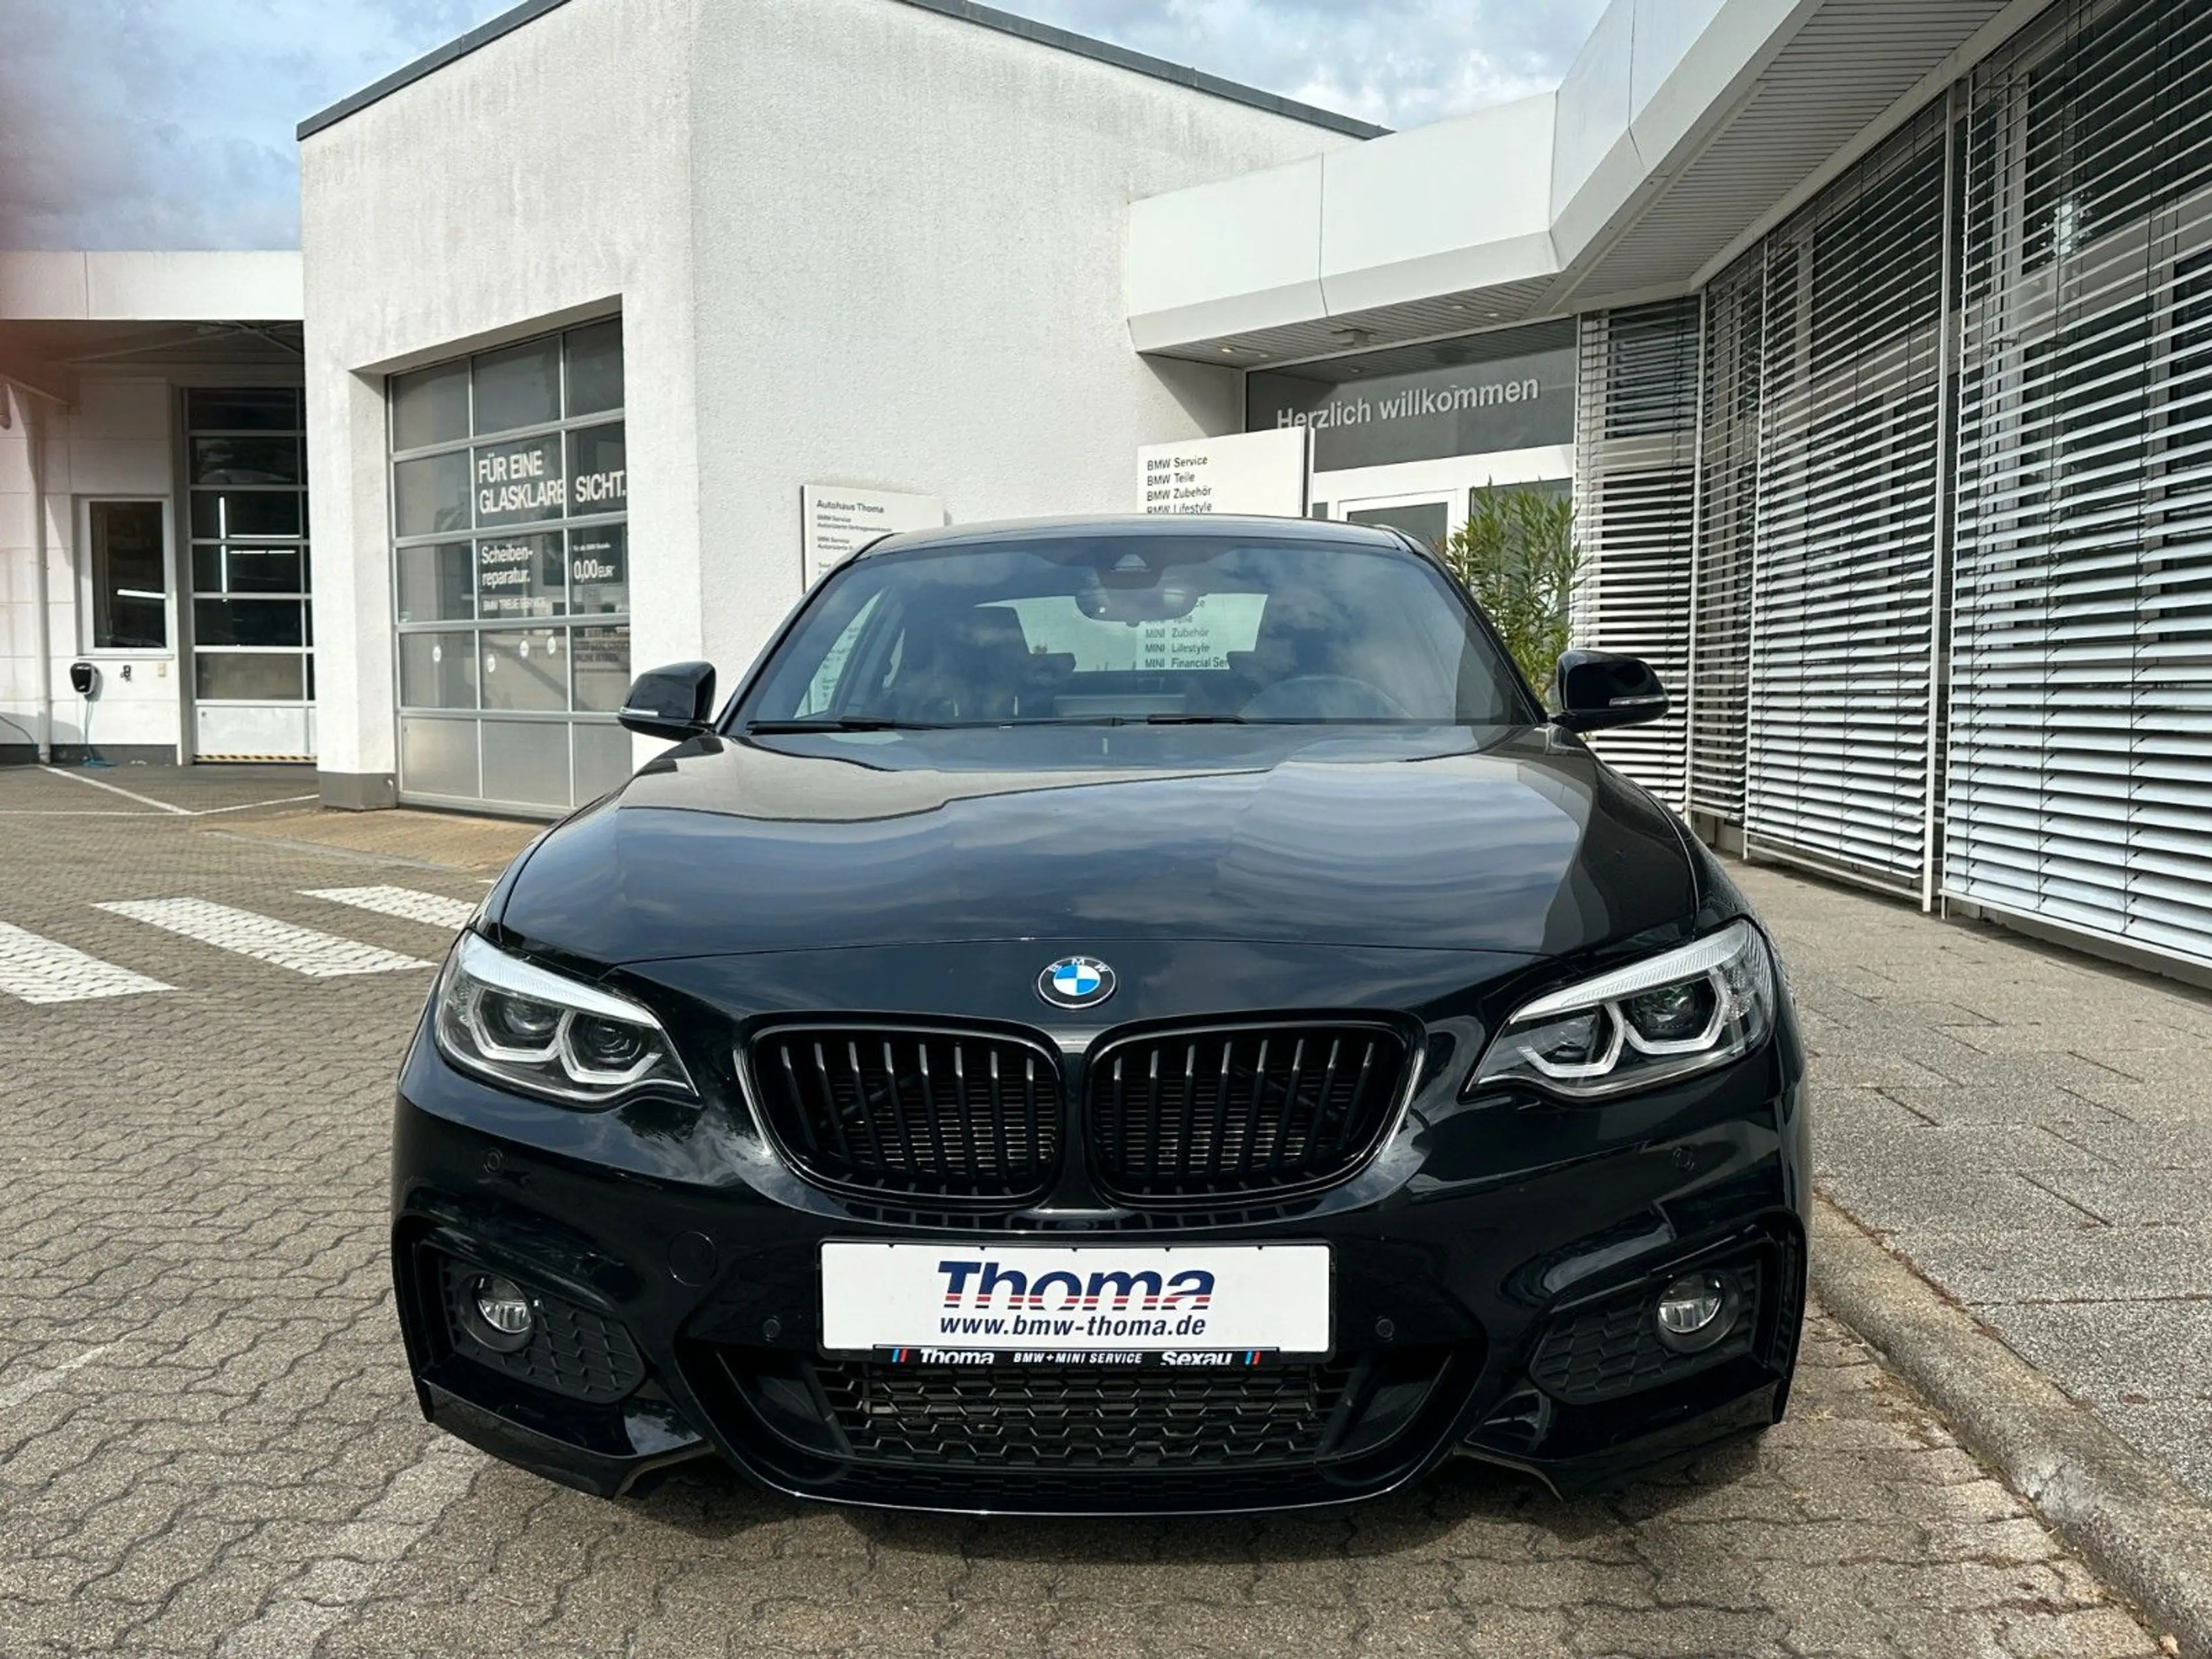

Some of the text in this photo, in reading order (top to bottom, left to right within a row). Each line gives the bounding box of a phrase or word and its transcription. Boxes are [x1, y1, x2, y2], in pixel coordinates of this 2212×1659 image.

[1277, 377, 1539, 430] Herzlich willkommen
[479, 450, 544, 483] FÜR EINE
[1147, 456, 1208, 471] BMW Service
[1147, 471, 1195, 486] BMW Teile
[479, 470, 627, 514] GLASKLARE SICHT.
[1147, 486, 1212, 501] BMW Zubehör
[816, 499, 884, 513] Autohaus Thoma
[1174, 502, 1212, 514] Lifestyle
[481, 544, 533, 565] Scheiben-
[482, 567, 531, 590] reparatur.
[1145, 627, 1165, 638] MINI
[1145, 643, 1165, 653] MINI
[1145, 658, 1165, 668] MINI
[1171, 657, 1211, 668] Financial
[938, 1260, 1215, 1311] Thoma
[940, 1314, 1206, 1336] www.bmw-thoma.de
[920, 1349, 995, 1365] Thoma
[1089, 1353, 1143, 1364] SERVICE
[1160, 1351, 1233, 1366] Sexau
